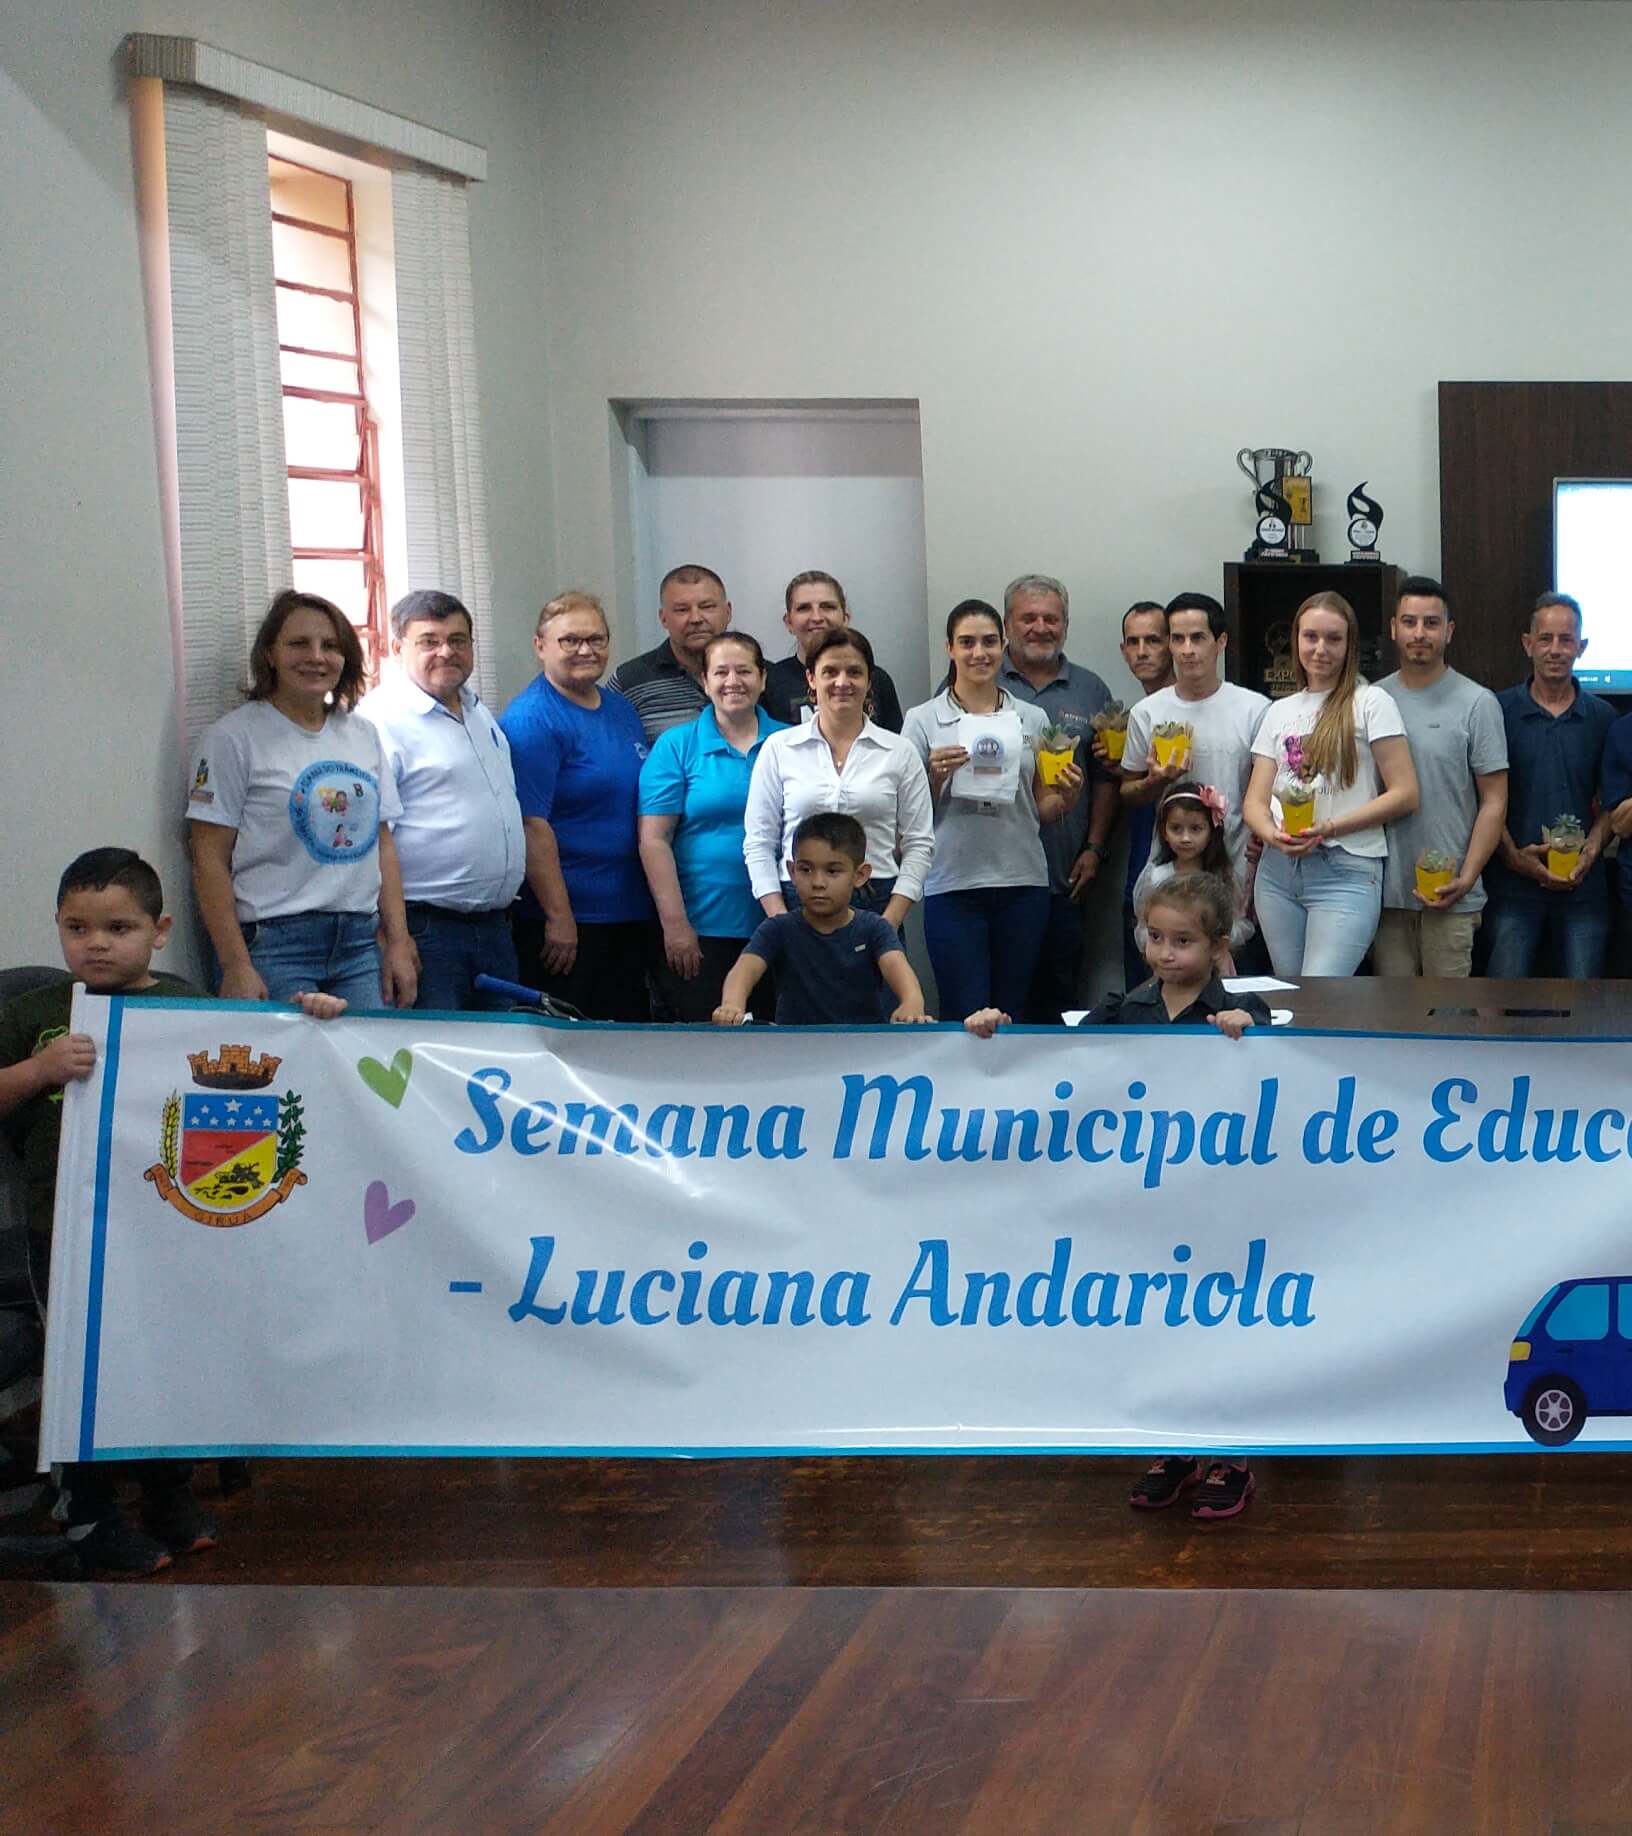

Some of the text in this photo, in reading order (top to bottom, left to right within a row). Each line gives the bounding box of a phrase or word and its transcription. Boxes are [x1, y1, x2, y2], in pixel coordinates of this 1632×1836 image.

[454, 1067, 808, 1160] Semana
[832, 1074, 1279, 1189] Municipal
[1302, 1076, 1400, 1165] de
[507, 1235, 872, 1327] Luciana
[889, 1237, 1317, 1328] Andariola
